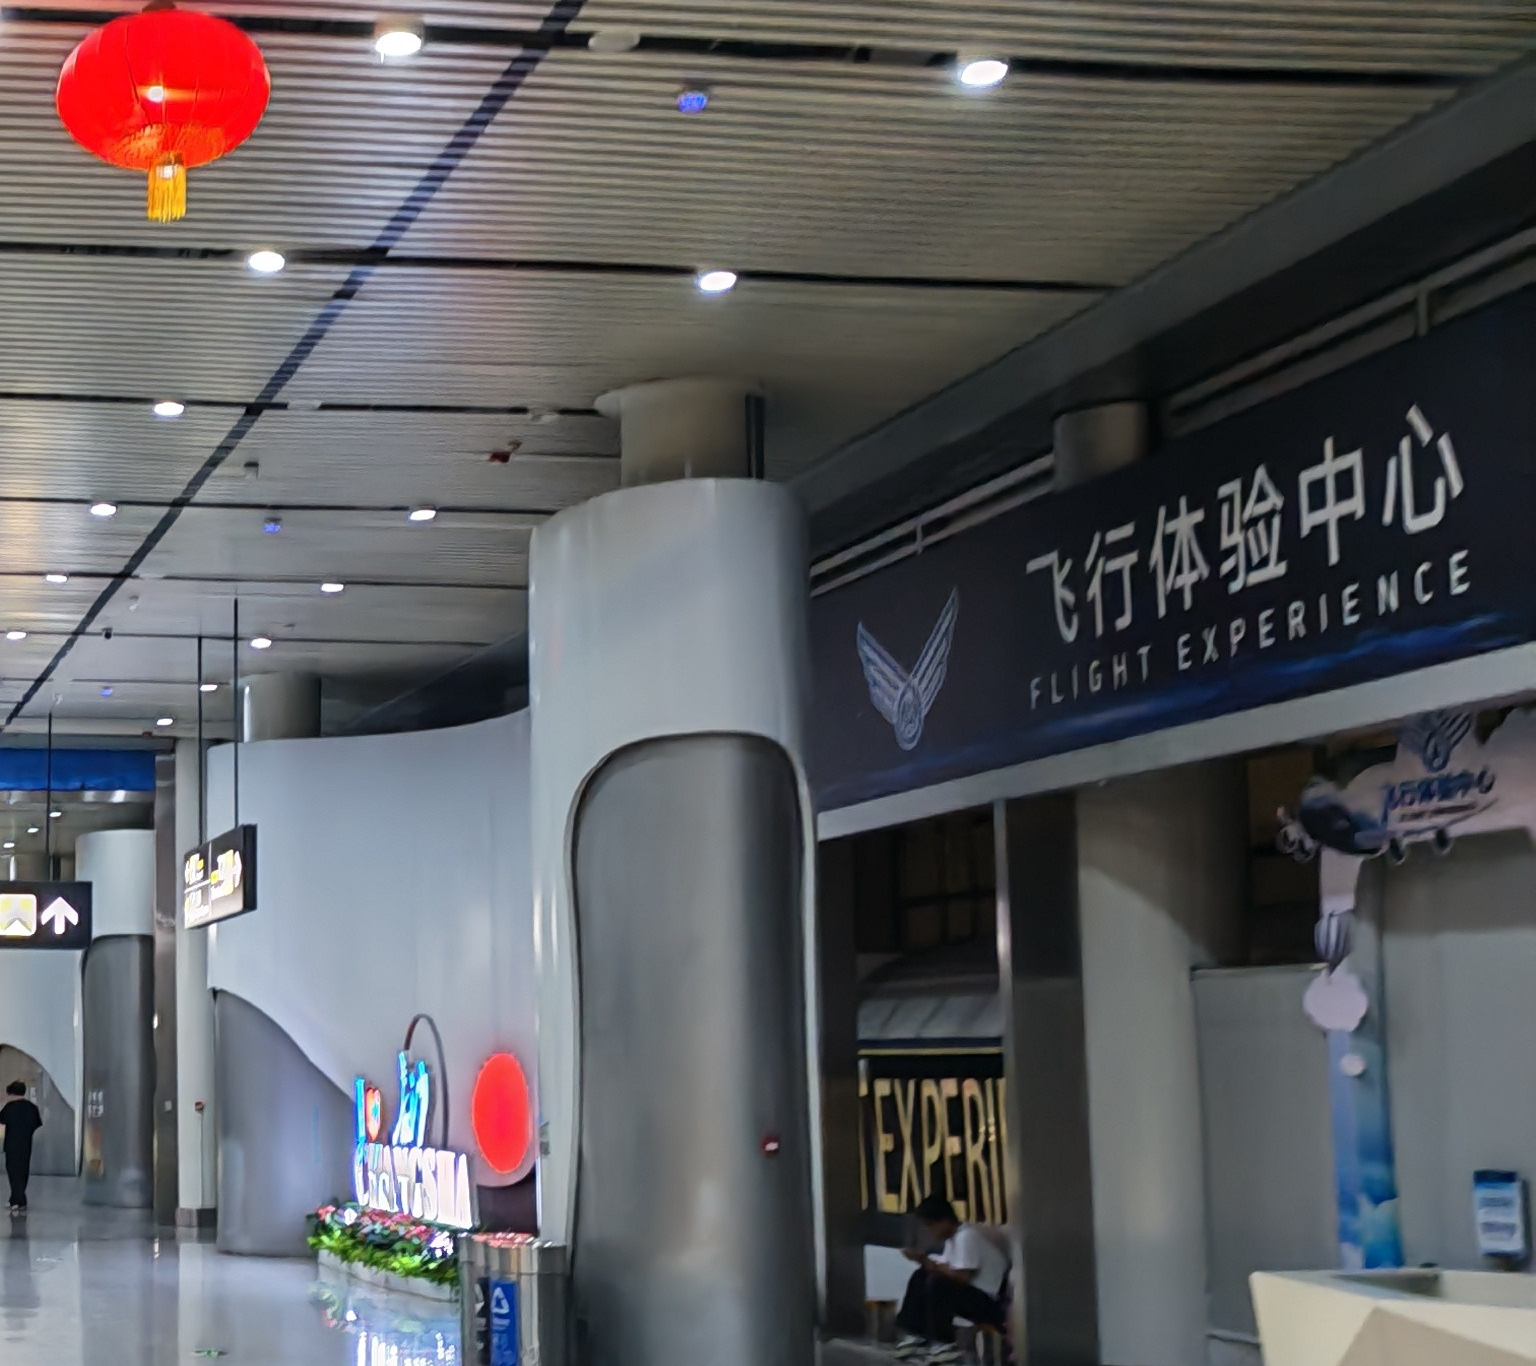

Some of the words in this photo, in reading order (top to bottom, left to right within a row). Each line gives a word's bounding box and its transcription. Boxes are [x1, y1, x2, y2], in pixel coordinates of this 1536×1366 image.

[1026, 403, 1464, 644] 飞行体验中心
[1029, 645, 1152, 711] FLIGHT
[1177, 549, 1471, 672] EXPERIENCE
[874, 1076, 1008, 1226] EXPERI
